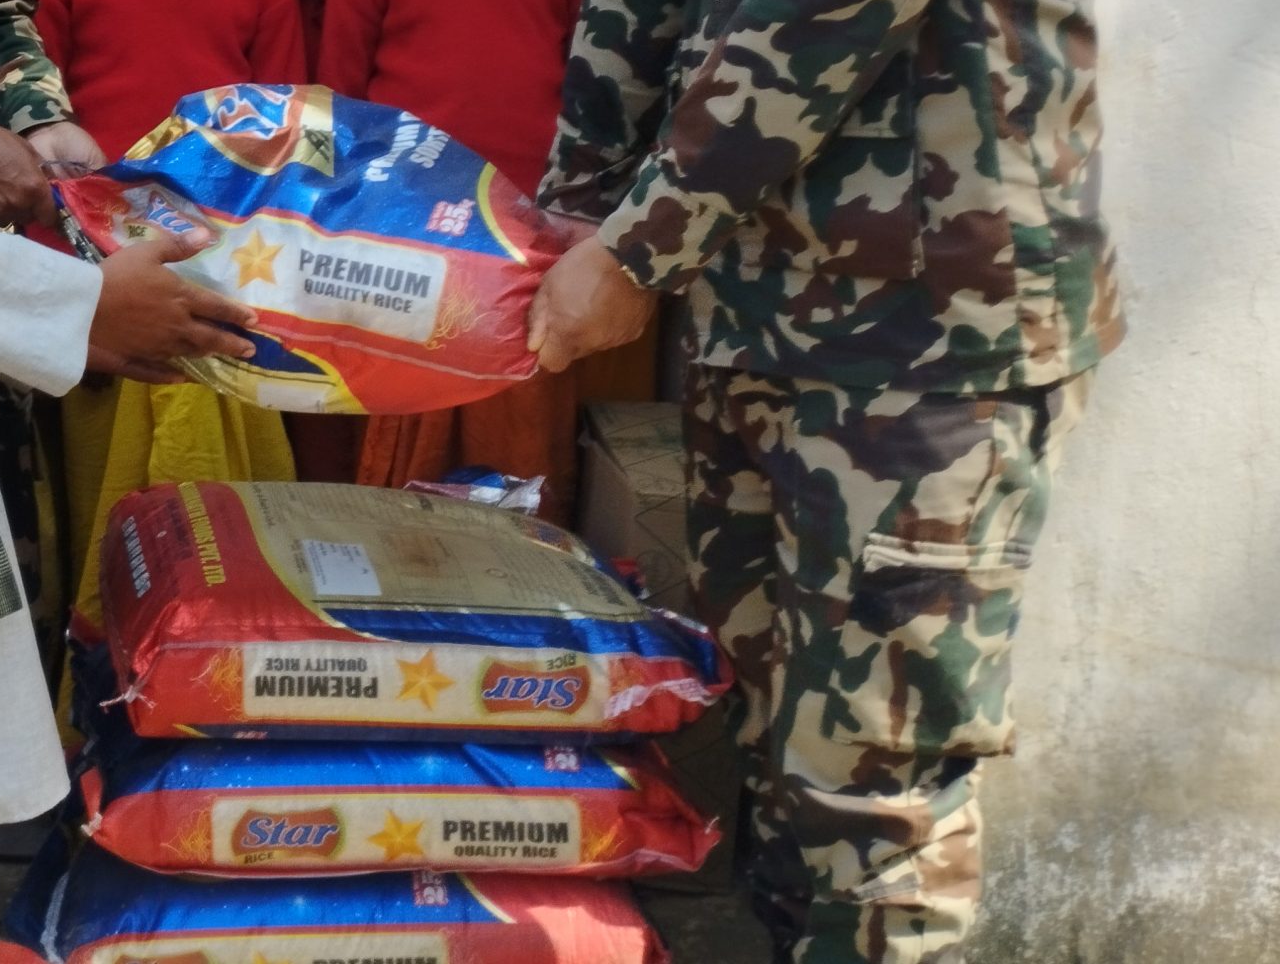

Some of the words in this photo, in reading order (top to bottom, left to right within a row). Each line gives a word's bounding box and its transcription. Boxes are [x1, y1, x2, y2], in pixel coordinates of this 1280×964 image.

[299, 248, 432, 299] PREMIUM
[304, 278, 370, 304] QUALITY
[373, 292, 414, 314] RICE
[266, 657, 301, 672] RICE
[304, 657, 368, 673] QUALITY
[546, 652, 577, 671] RICE
[254, 675, 379, 699] PREMIUM
[482, 675, 583, 710] Star
[241, 816, 340, 849] Star
[442, 820, 569, 844] PREMIUM
[243, 851, 274, 865] RICE
[453, 844, 518, 858] QUALITY
[521, 845, 558, 859] RICE
